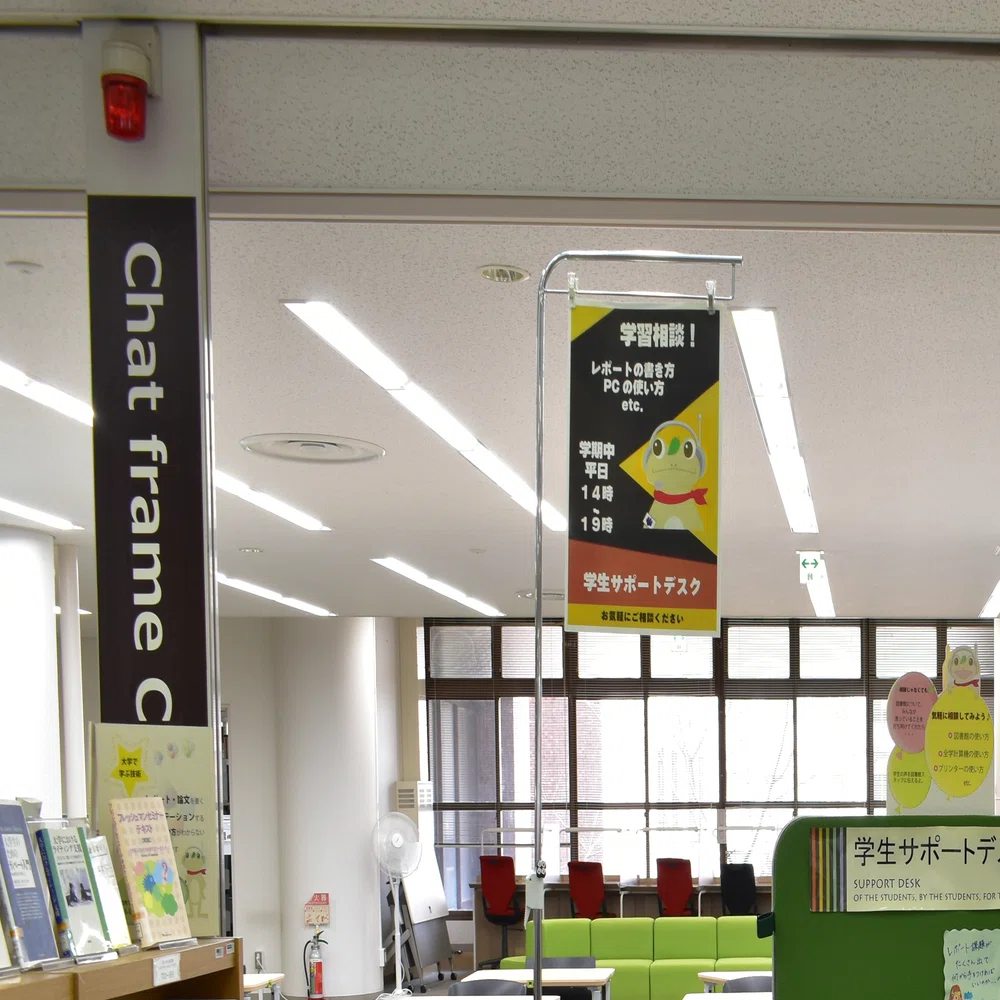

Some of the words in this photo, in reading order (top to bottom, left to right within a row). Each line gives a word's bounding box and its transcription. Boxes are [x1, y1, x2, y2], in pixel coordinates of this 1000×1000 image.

[124, 242, 164, 411] Chat
[591, 361, 675, 379] レポートの書き方
[621, 399, 643, 412] etc.
[579, 440, 615, 460] 学期中
[585, 462, 609, 480] 平日
[129, 434, 168, 651] frame
[583, 571, 701, 597] 学生サポートデスク
[601, 610, 684, 625] お気軽にご相談ください
[135, 677, 173, 722] C
[953, 732, 990, 741] 図書館の使い方
[121, 758, 138, 766] 大学で
[939, 765, 984, 773] プリンターの使い方
[118, 770, 141, 778] 学ぶ技術
[853, 878, 895, 889] SUPPORT
[898, 878, 921, 889] DESK
[853, 894, 863, 902] OF
[880, 893, 917, 902] STUDENTS,
[919, 893, 928, 901] BY
[945, 892, 981, 901] STUDENTS,
[983, 892, 996, 900] FOR
